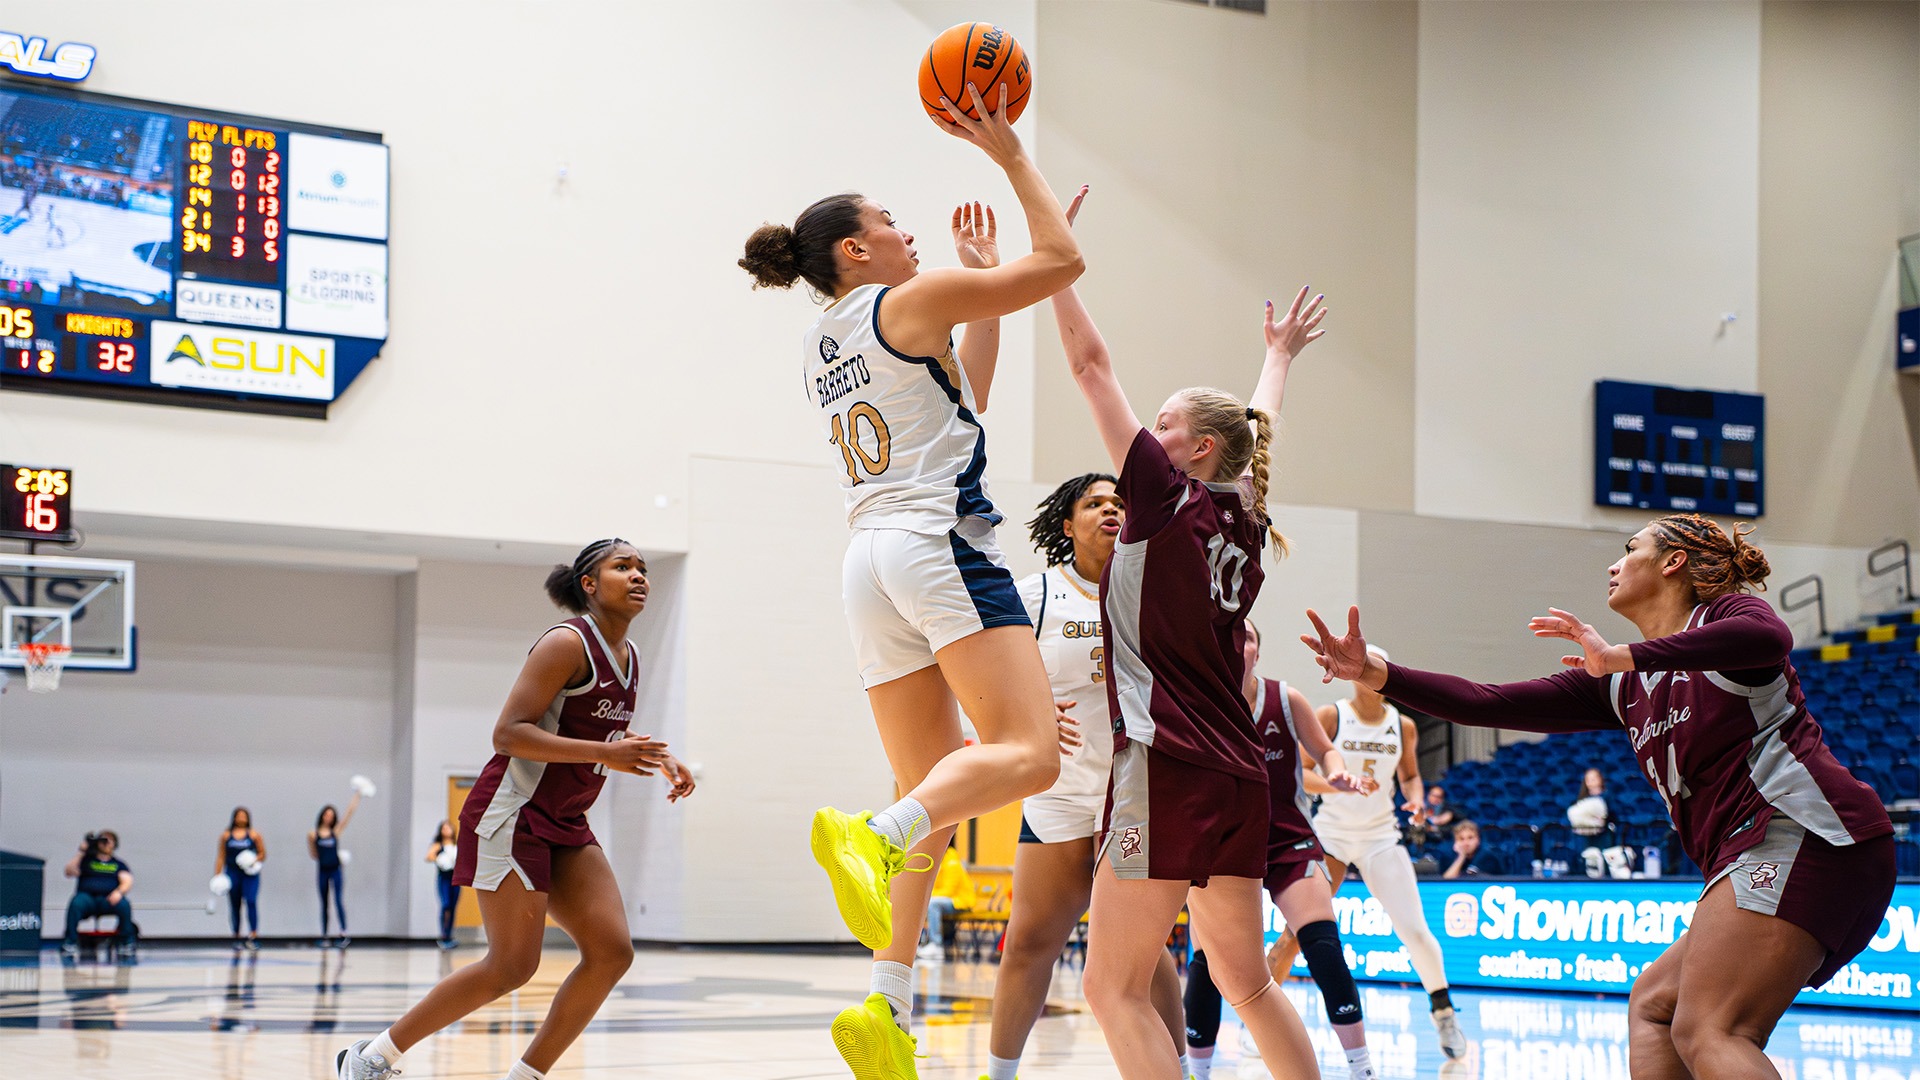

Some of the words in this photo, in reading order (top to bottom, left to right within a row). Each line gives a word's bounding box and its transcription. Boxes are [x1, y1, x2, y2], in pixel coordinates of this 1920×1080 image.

[190, 141, 213, 164] 10
[230, 147, 246, 168] 0
[264, 151, 280, 173] 2
[189, 164, 212, 186] 12
[230, 169, 246, 191] 0
[258, 174, 280, 195] 12
[189, 187, 212, 207] 14
[237, 194, 246, 212] 1
[258, 196, 280, 218] 13
[181, 206, 212, 230] 21
[237, 216, 246, 234] 1
[263, 218, 279, 240] 0
[183, 230, 212, 253] 34
[231, 236, 245, 258] 3
[263, 240, 279, 262] 5
[179, 287, 275, 313] QUEENS
[66, 313, 133, 338] KNIGHTS
[37, 350, 55, 373] 2
[98, 341, 135, 373] 32
[815, 354, 871, 408] BARRETO
[829, 401, 891, 487] 10
[15, 468, 69, 495] 2:05
[25, 493, 58, 531] 16
[1207, 533, 1249, 612] 10
[1342, 740, 1398, 755] QUEENS
[1362, 759, 1376, 778] 5
[1478, 950, 1562, 980] southern
[1575, 953, 1628, 983] fresh
